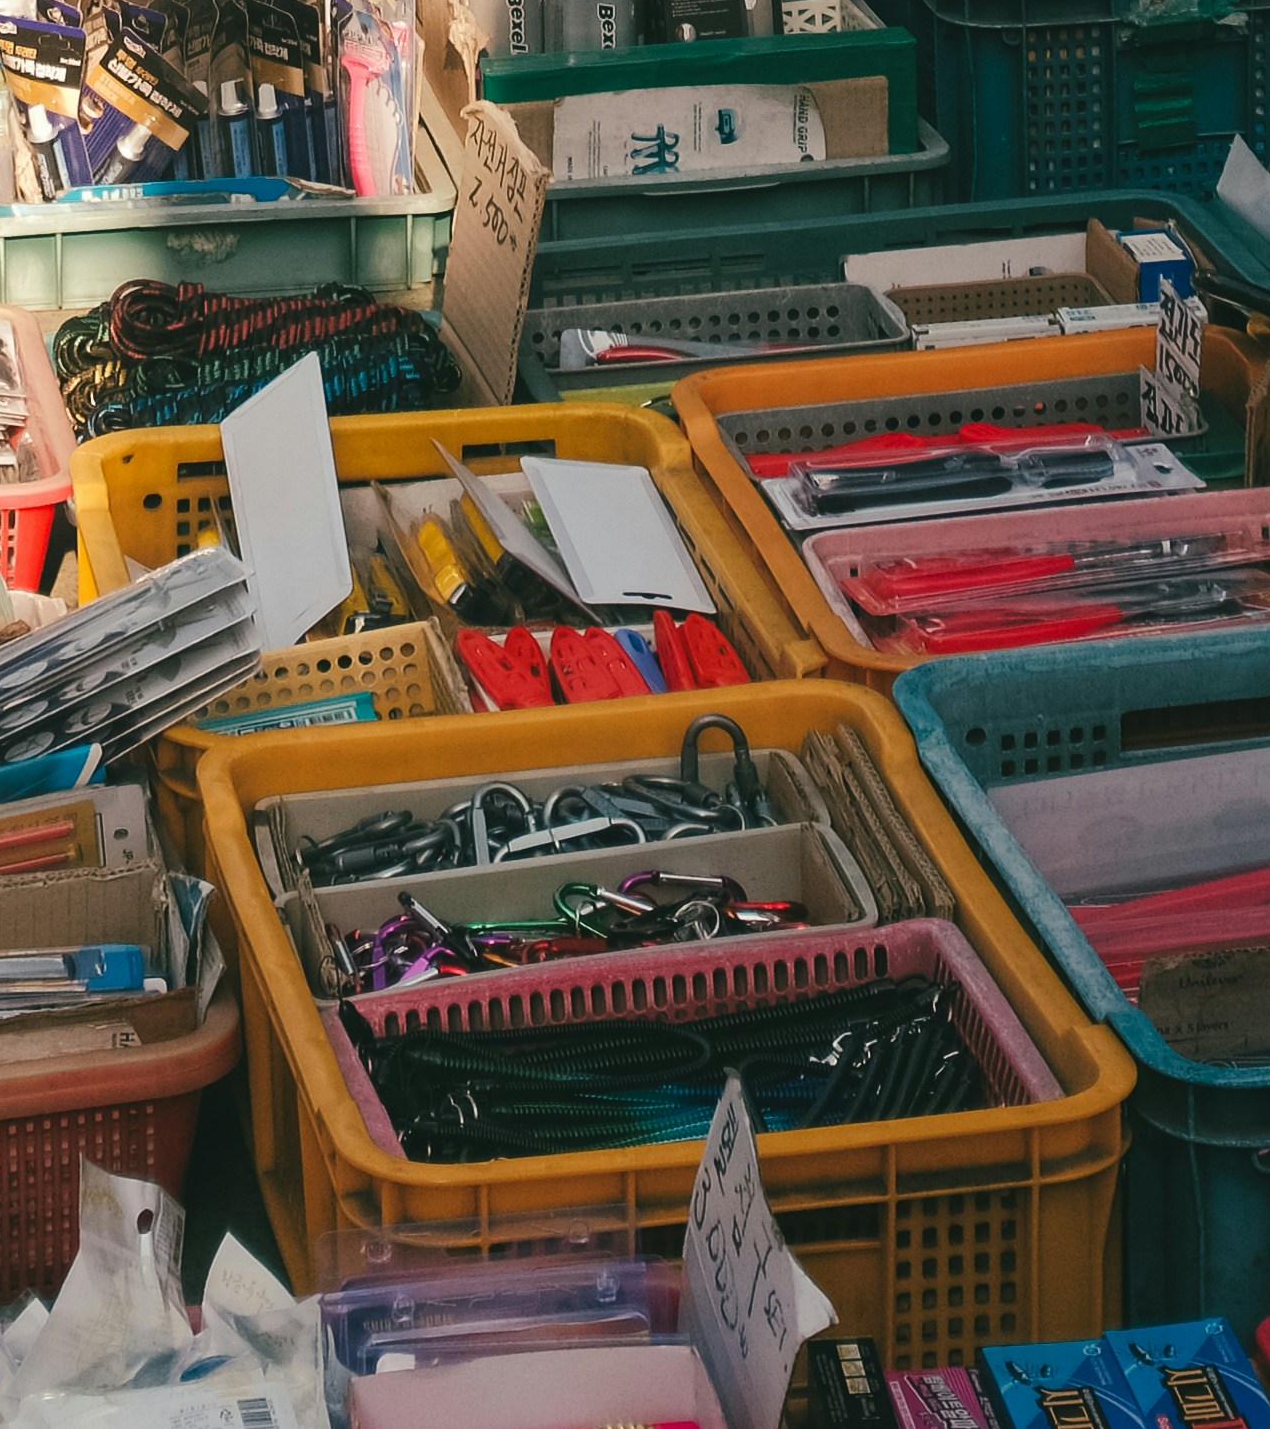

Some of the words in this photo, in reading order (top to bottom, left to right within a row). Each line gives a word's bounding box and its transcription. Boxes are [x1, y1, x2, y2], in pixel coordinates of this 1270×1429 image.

[596, 2, 618, 51] Bex
[797, 93, 811, 126] HAND
[796, 126, 809, 153] GRIP
[1178, 973, 1243, 991] Unilever
